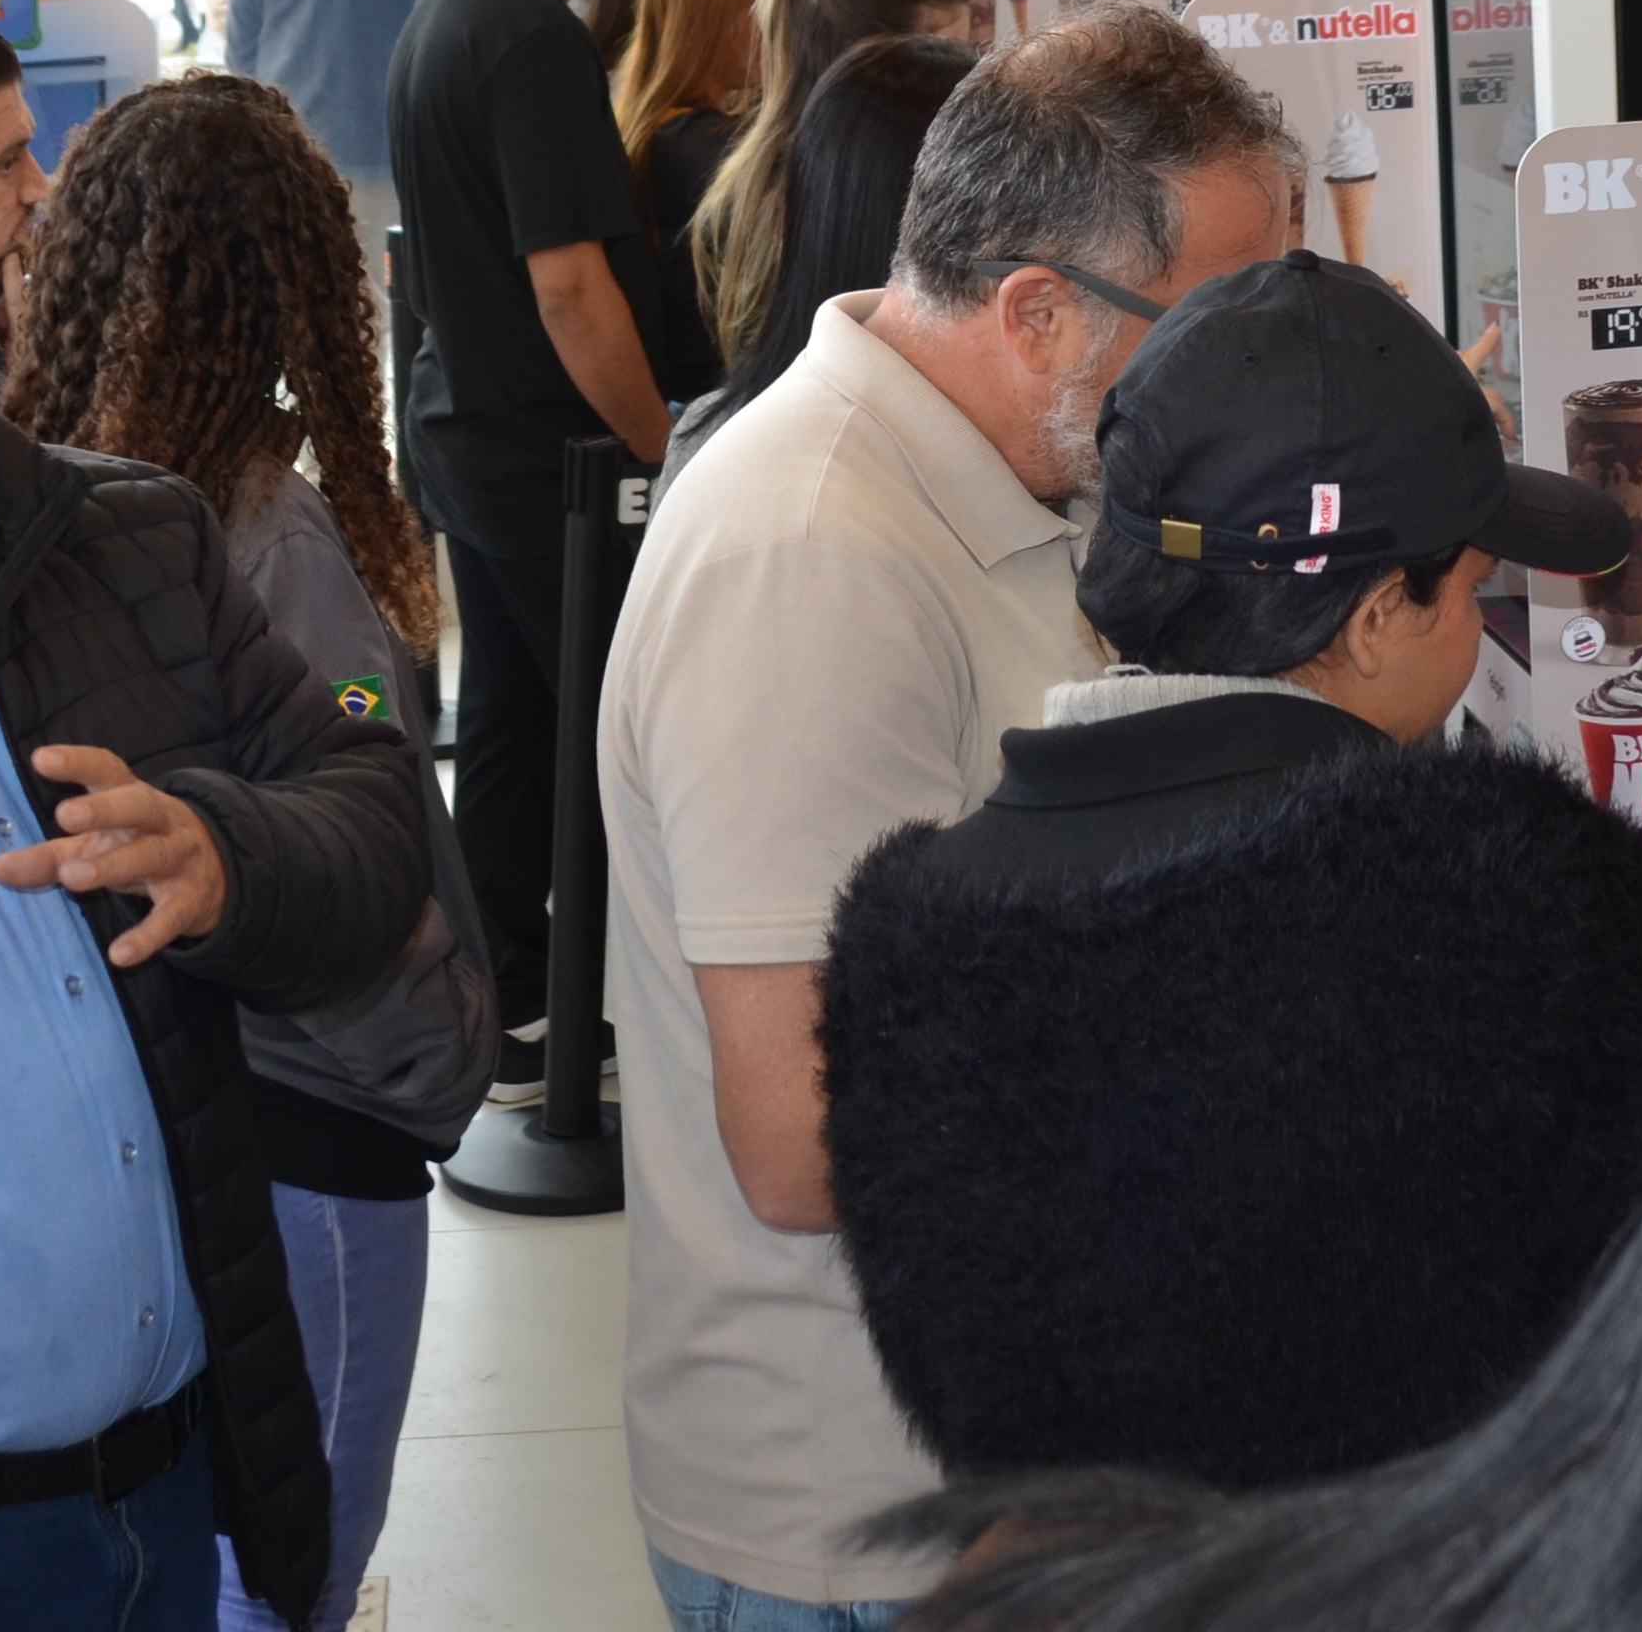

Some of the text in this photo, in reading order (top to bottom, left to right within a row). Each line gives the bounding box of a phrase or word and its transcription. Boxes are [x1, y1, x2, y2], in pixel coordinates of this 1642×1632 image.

[1198, 4, 1417, 50] BK & nutella
[1543, 158, 1637, 215] BK
[1320, 495, 1333, 524] KING
